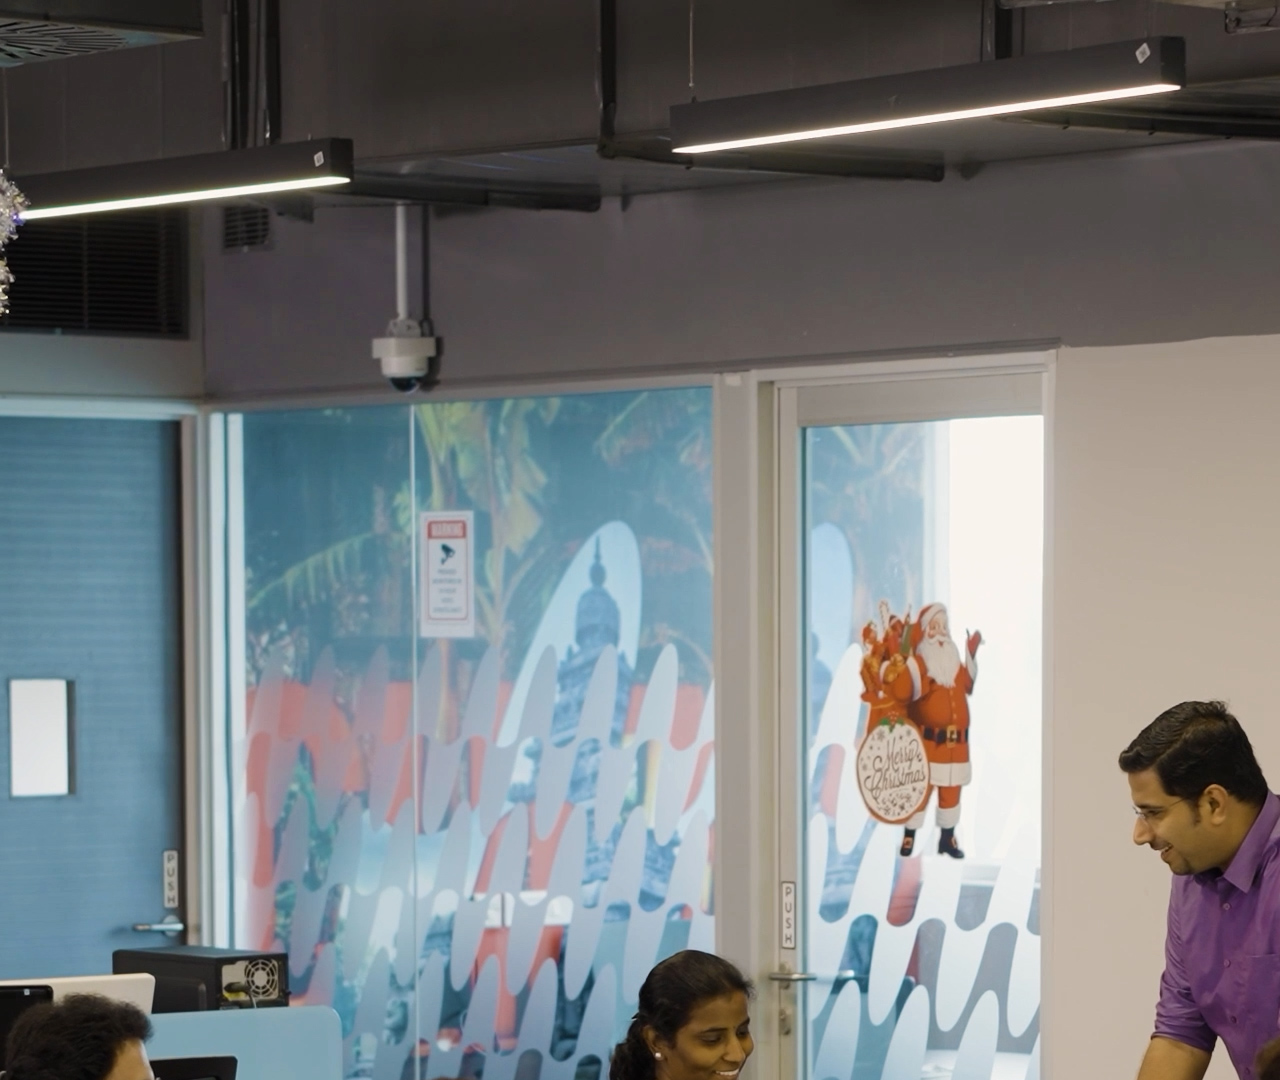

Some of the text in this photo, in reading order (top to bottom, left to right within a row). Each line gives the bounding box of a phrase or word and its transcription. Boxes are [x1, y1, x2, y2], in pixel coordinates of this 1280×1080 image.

[864, 755, 925, 799] Christmas
[883, 737, 919, 773] Merry
[166, 853, 176, 904] PUSH
[785, 886, 793, 944] PUSH
